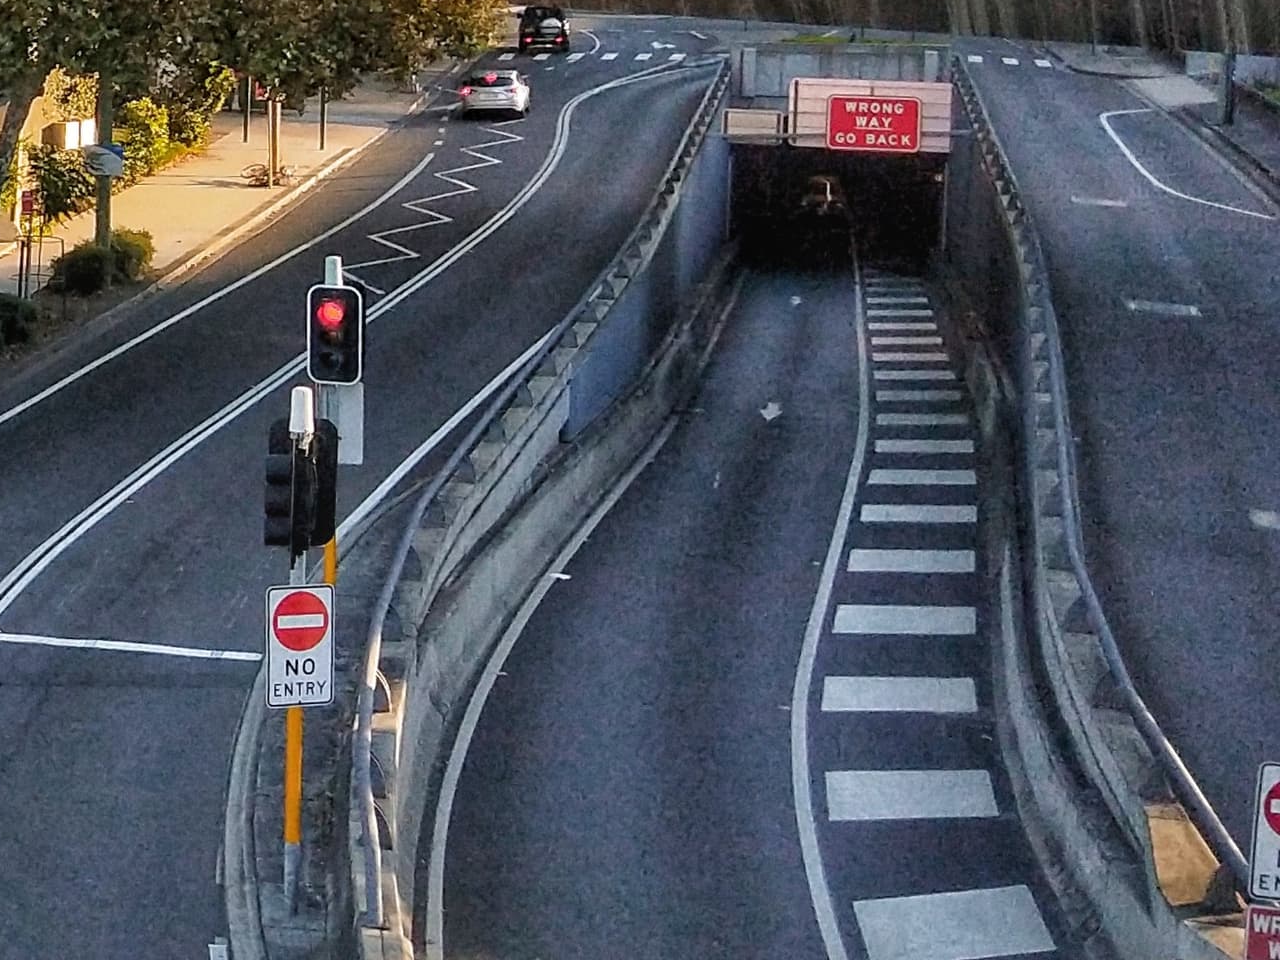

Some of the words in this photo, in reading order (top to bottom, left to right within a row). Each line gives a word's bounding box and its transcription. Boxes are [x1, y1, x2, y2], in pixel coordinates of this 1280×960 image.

[846, 101, 904, 114] WRONG
[855, 116, 892, 128] WAY
[835, 133, 856, 144] GO
[866, 133, 911, 146] BACK
[285, 659, 315, 677] NO
[274, 681, 327, 697] ENTRY
